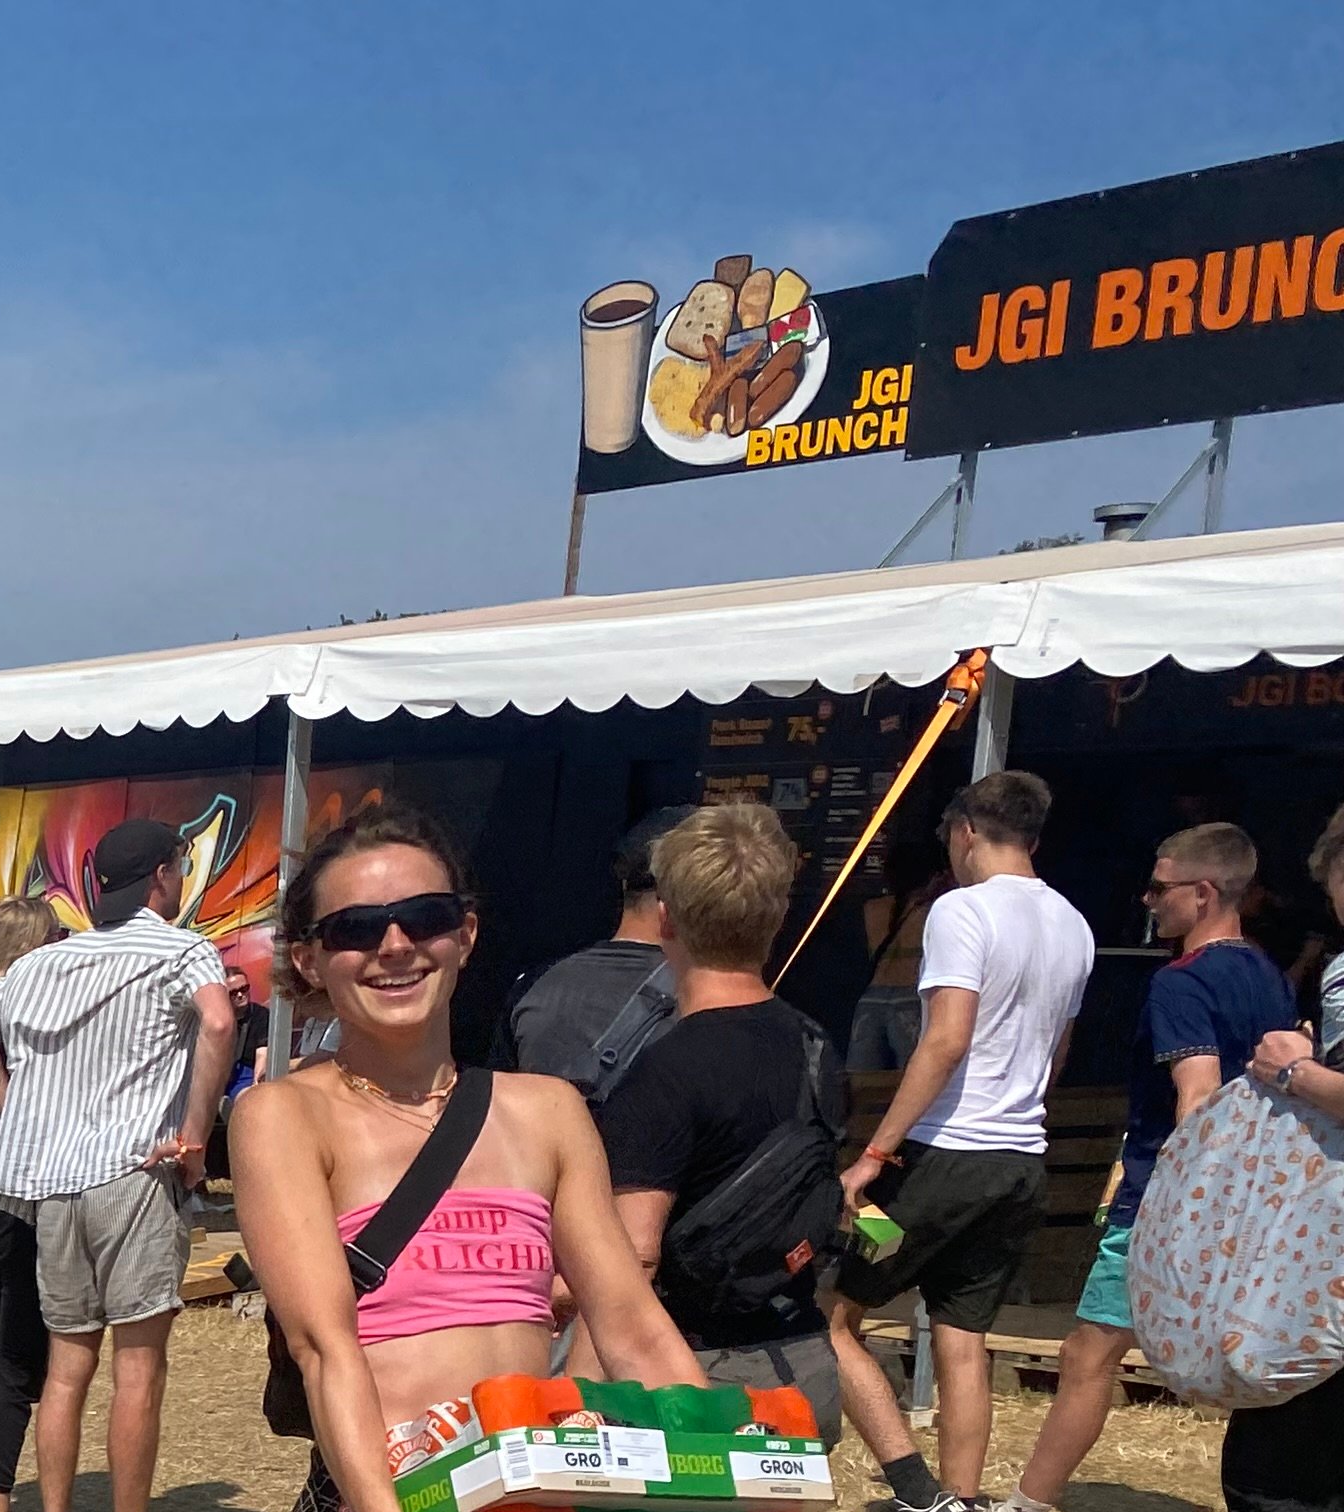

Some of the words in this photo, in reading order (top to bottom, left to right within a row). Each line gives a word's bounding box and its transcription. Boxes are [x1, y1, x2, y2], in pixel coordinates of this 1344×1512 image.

[955, 278, 1072, 372] JGI
[853, 363, 914, 410] JGI
[745, 405, 909, 467] BRUNCH
[1226, 672, 1296, 708] JGI
[432, 1209, 508, 1235] amp
[565, 1452, 601, 1468] GRØ
[760, 1459, 805, 1475] GRØN
